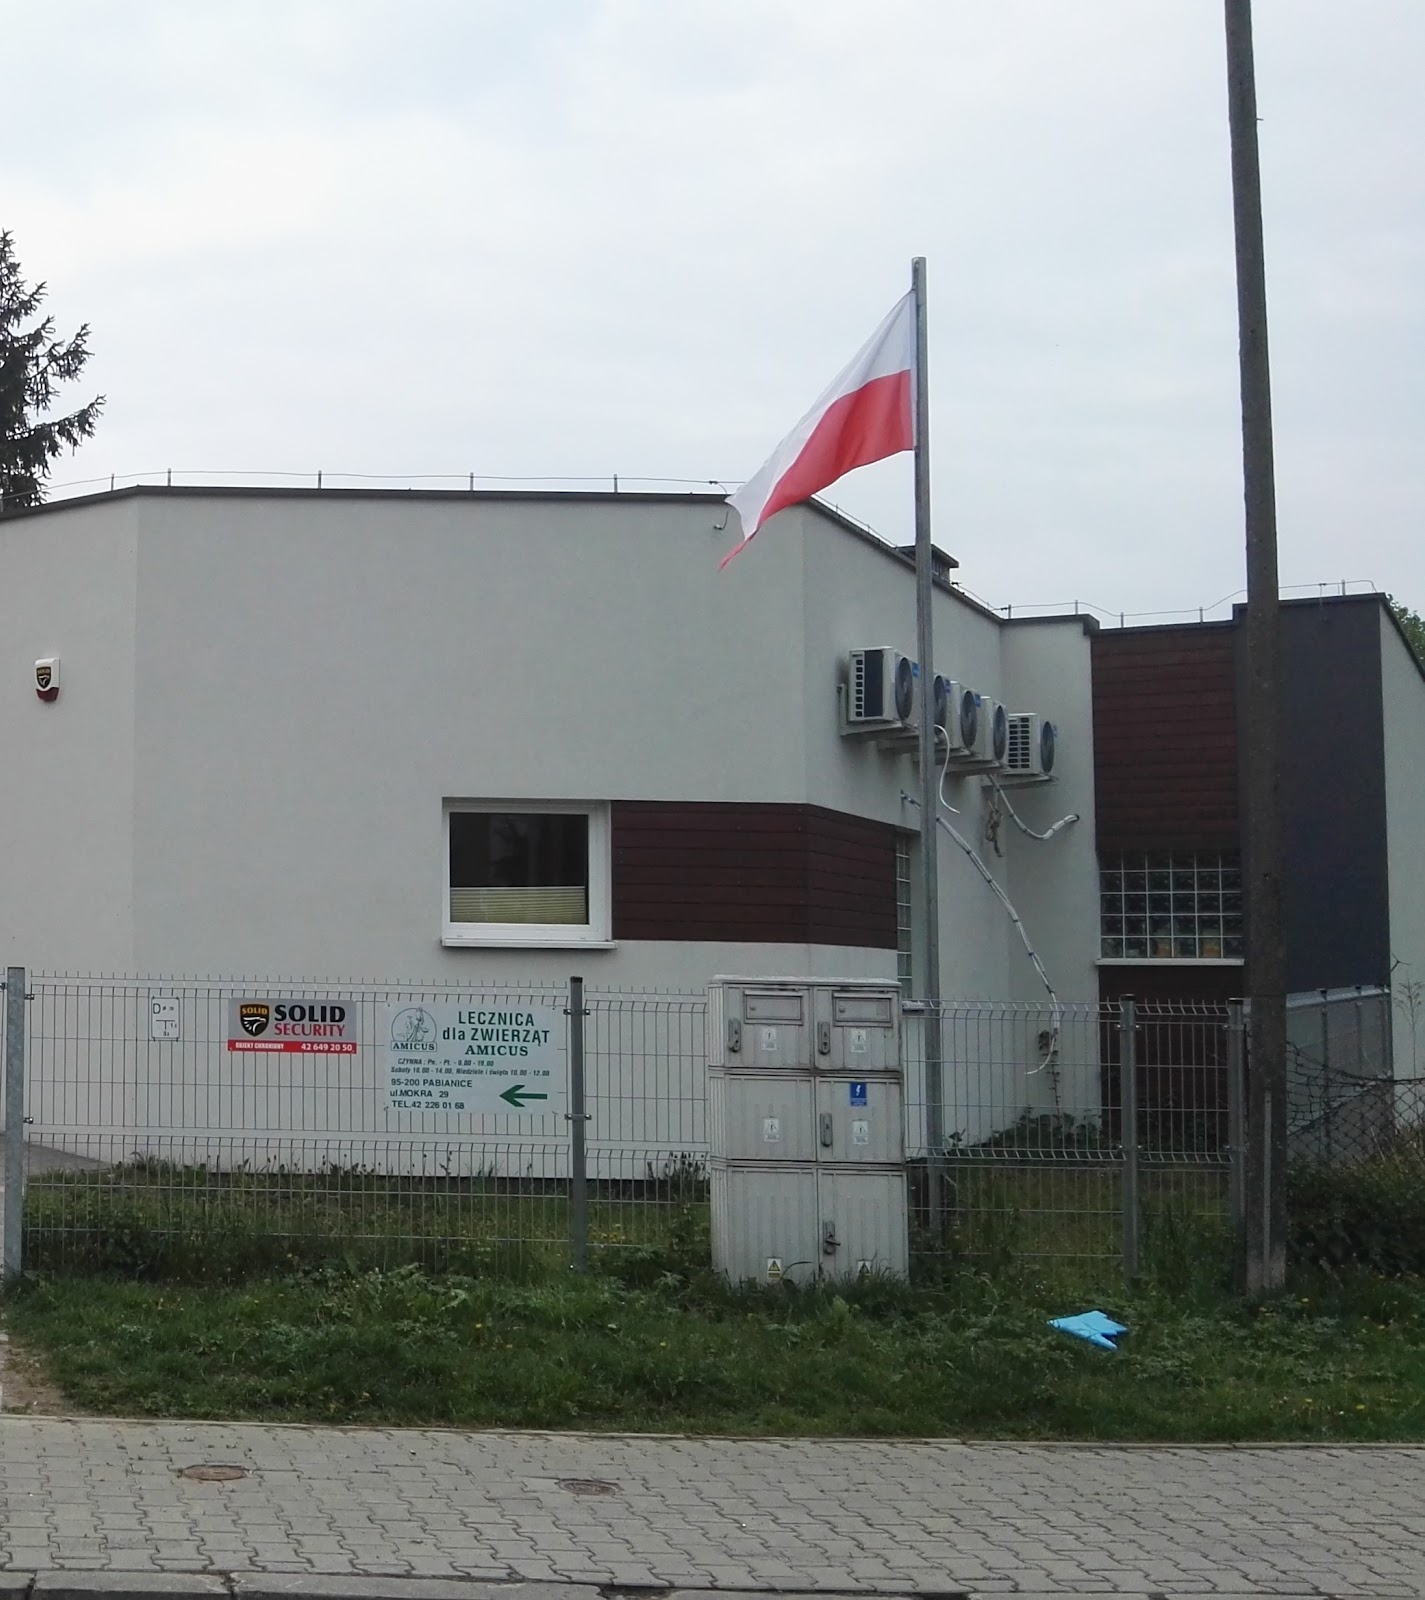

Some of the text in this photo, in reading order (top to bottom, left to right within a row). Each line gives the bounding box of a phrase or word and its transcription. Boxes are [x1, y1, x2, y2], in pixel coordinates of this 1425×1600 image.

[242, 1006, 268, 1015] SOLID
[274, 1004, 346, 1023] SOLID
[458, 1011, 535, 1027] LECZNICA
[274, 1023, 345, 1037] SECURITY
[442, 1027, 550, 1047] dla ZWIERZĄT
[313, 1043, 328, 1051] 649
[330, 1043, 341, 1051] 20
[392, 1042, 435, 1051] AMICUS
[465, 1044, 528, 1057] AMICUS
[391, 1078, 473, 1088] 95-200 PABIANICE
[438, 1090, 449, 1098] 29
